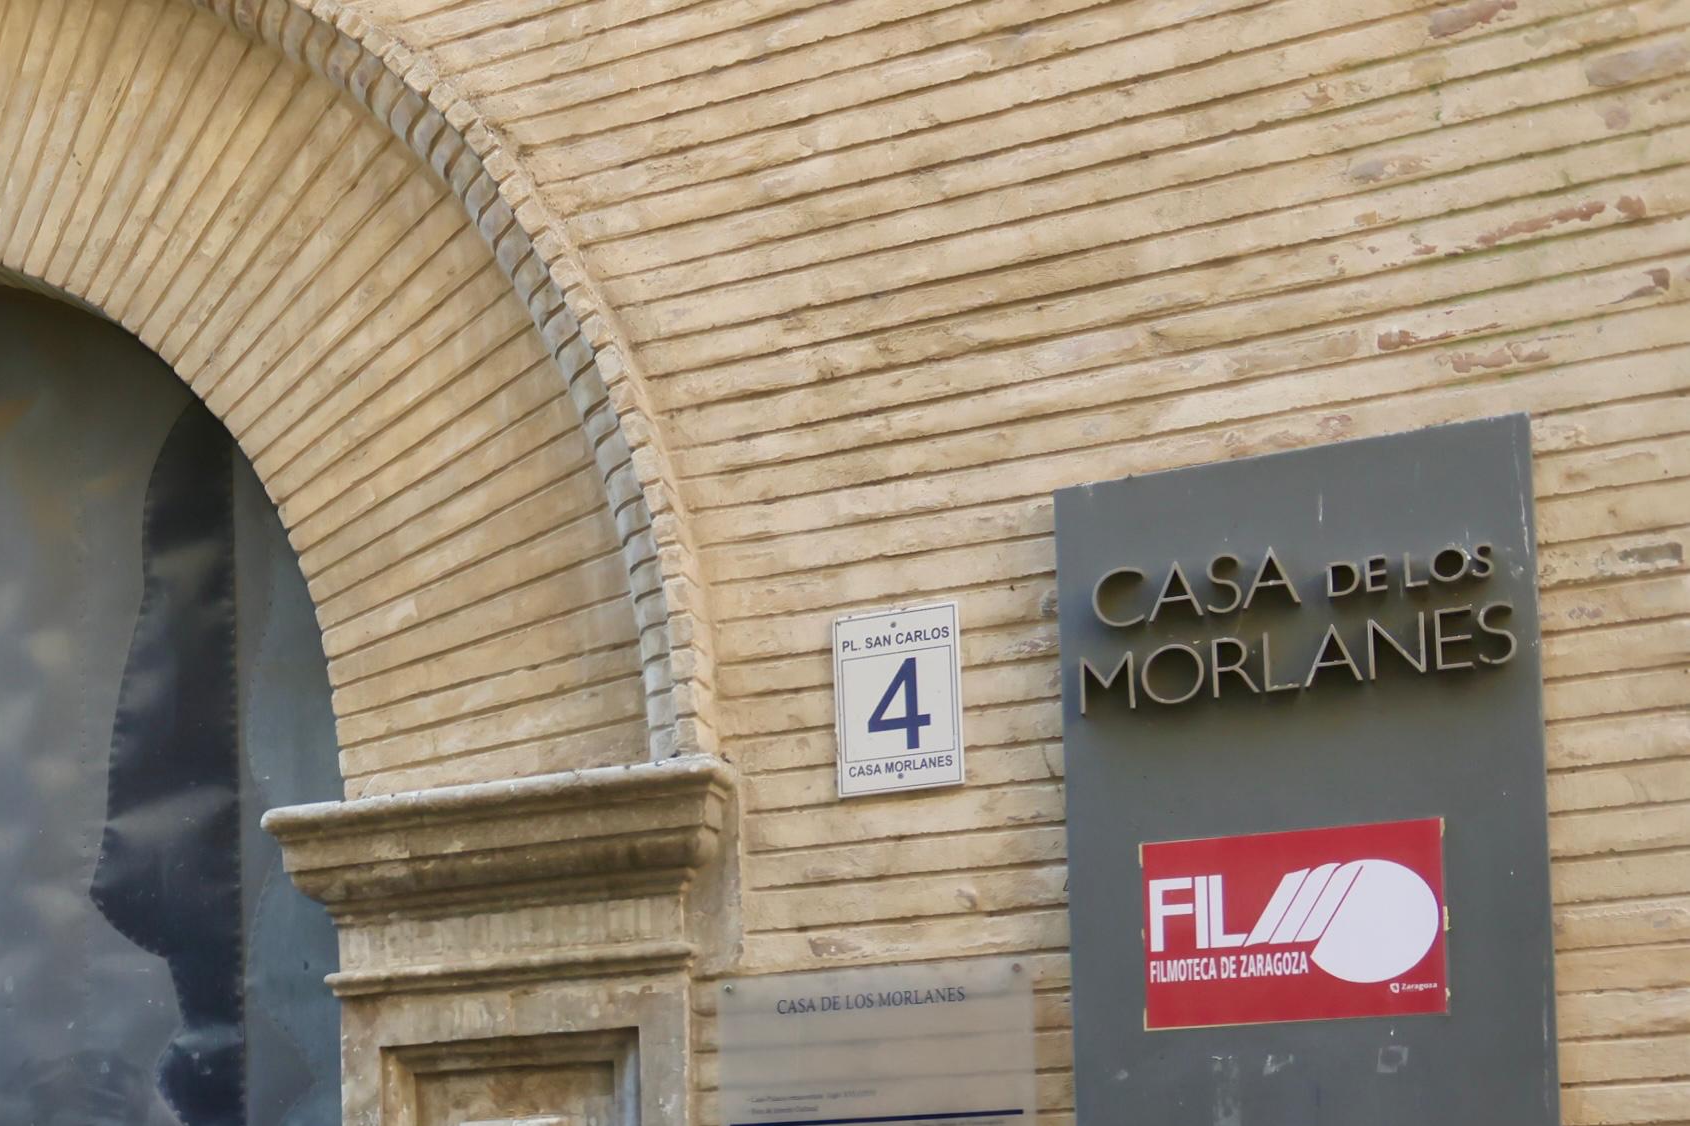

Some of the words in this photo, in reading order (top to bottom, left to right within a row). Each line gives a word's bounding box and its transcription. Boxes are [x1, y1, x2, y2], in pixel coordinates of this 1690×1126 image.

[1092, 545, 1302, 628] CASA
[1326, 553, 1389, 598] DE
[1403, 542, 1494, 588] LOS
[842, 639, 862, 652] PL.
[865, 634, 891, 649] SAN
[895, 626, 950, 644] CARLOS
[1079, 603, 1518, 715] MORLANES
[867, 656, 931, 750] 4
[849, 763, 882, 778] CASA
[885, 755, 953, 773] MORLANES
[1150, 958, 1217, 983] FILMOTECA
[1220, 956, 1238, 979] DE
[1240, 951, 1309, 978] ZARAGOZA
[776, 998, 816, 1015] CASA
[821, 995, 841, 1012] DE
[845, 993, 874, 1010] LOS
[878, 986, 966, 1007] MORLANES
